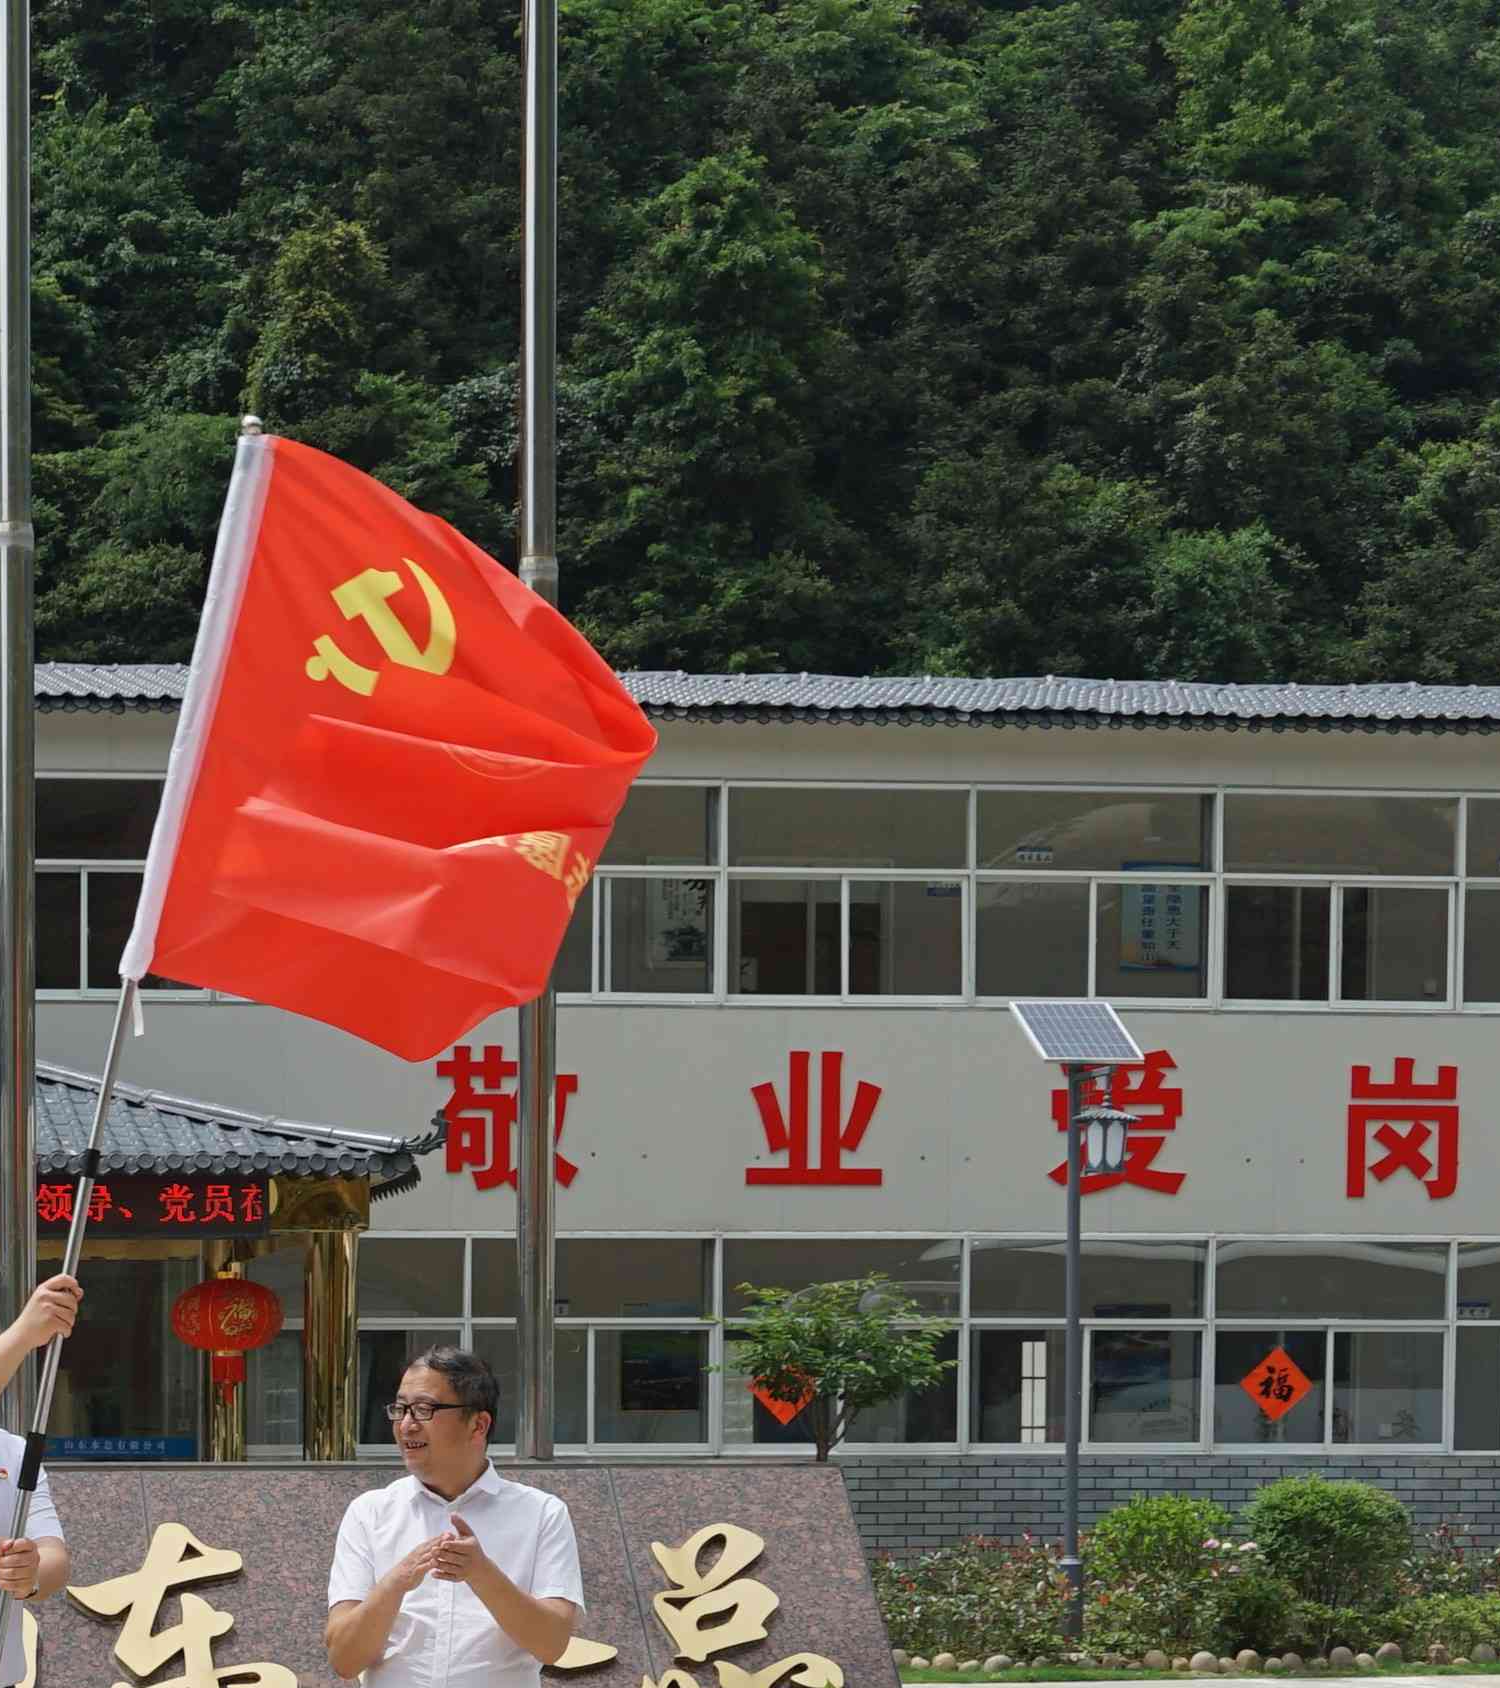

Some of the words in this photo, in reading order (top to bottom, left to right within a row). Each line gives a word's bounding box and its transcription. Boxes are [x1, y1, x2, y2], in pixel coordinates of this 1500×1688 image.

[435, 1044, 1460, 1199] 敬业爱岗
[1259, 1366, 1294, 1403] 福
